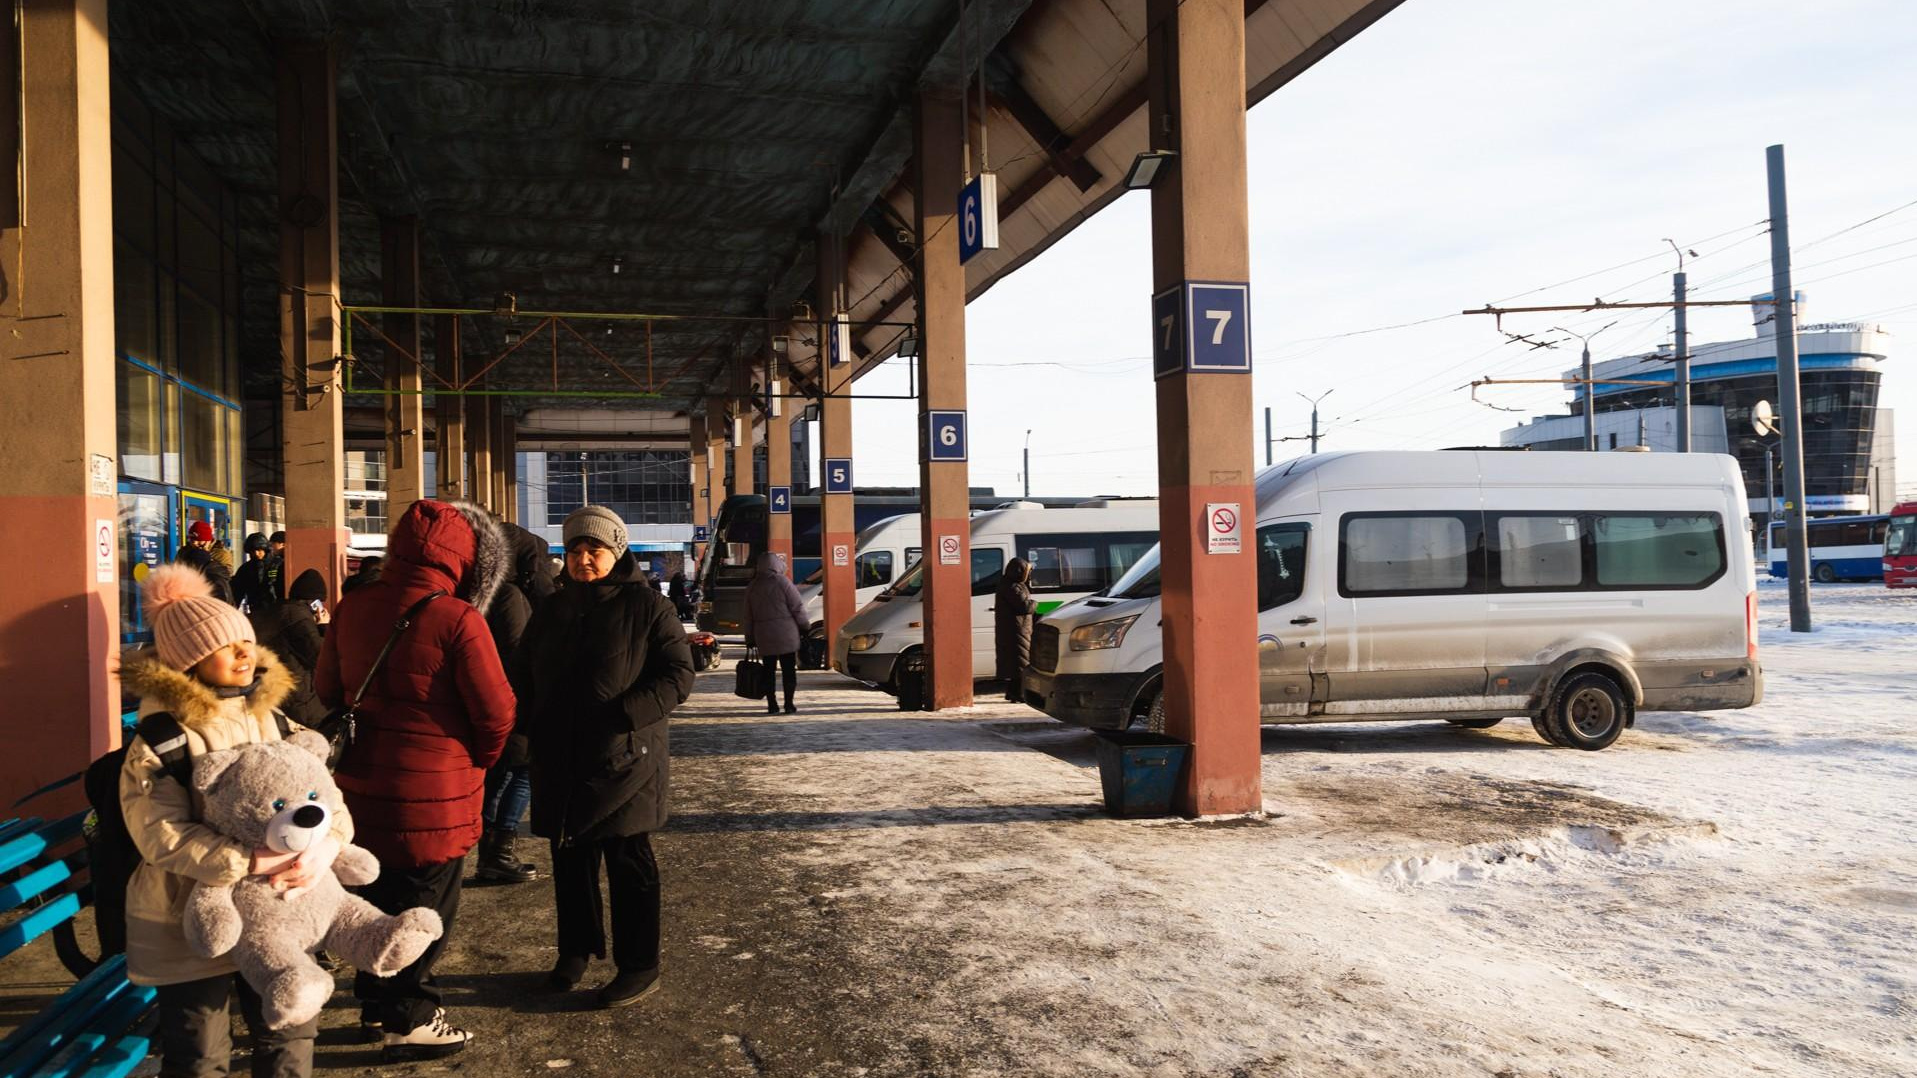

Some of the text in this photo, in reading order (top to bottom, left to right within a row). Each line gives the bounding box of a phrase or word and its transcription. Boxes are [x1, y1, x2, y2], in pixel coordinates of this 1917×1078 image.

[964, 195, 976, 247] 6
[1161, 314, 1174, 350] 7
[1206, 309, 1233, 345] 7
[940, 425, 957, 446] 6
[833, 468, 845, 483] 5
[775, 494, 786, 506] 4
